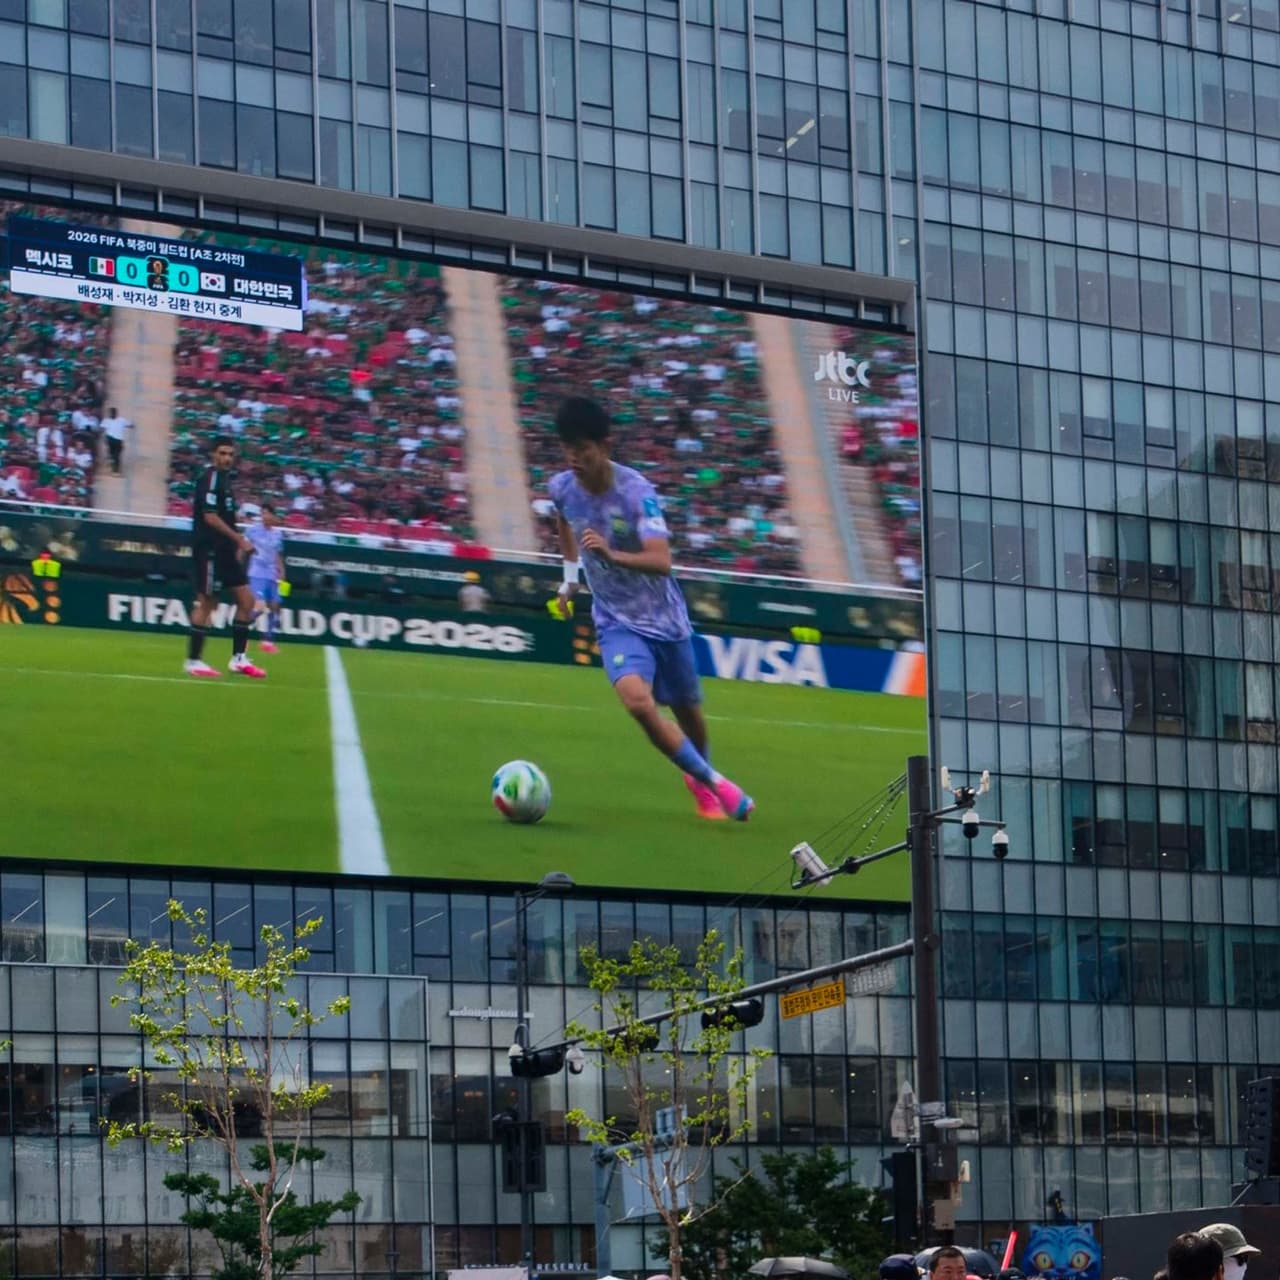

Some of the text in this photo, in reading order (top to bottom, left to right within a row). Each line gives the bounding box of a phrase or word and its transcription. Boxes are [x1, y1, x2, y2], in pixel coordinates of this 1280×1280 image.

[25, 248, 74, 269] 멕시코
[67, 230, 98, 244] 2026
[100, 235, 125, 248] FIFA
[127, 238, 157, 254] 북중미
[159, 243, 189, 258] 월드컵
[214, 253, 245, 268] 2차전]
[126, 262, 138, 279] 0
[178, 271, 190, 287] 0
[233, 276, 293, 301] 대한민국
[77, 285, 242, 318] 배성재 박지성 김환 현지 중계
[828, 388, 860, 404] LIVE
[108, 593, 192, 627] FIFA
[331, 611, 402, 643] CUP
[403, 618, 535, 653] 2026
[702, 633, 828, 688] VISA
[536, 1262, 589, 1271] RESERVE
